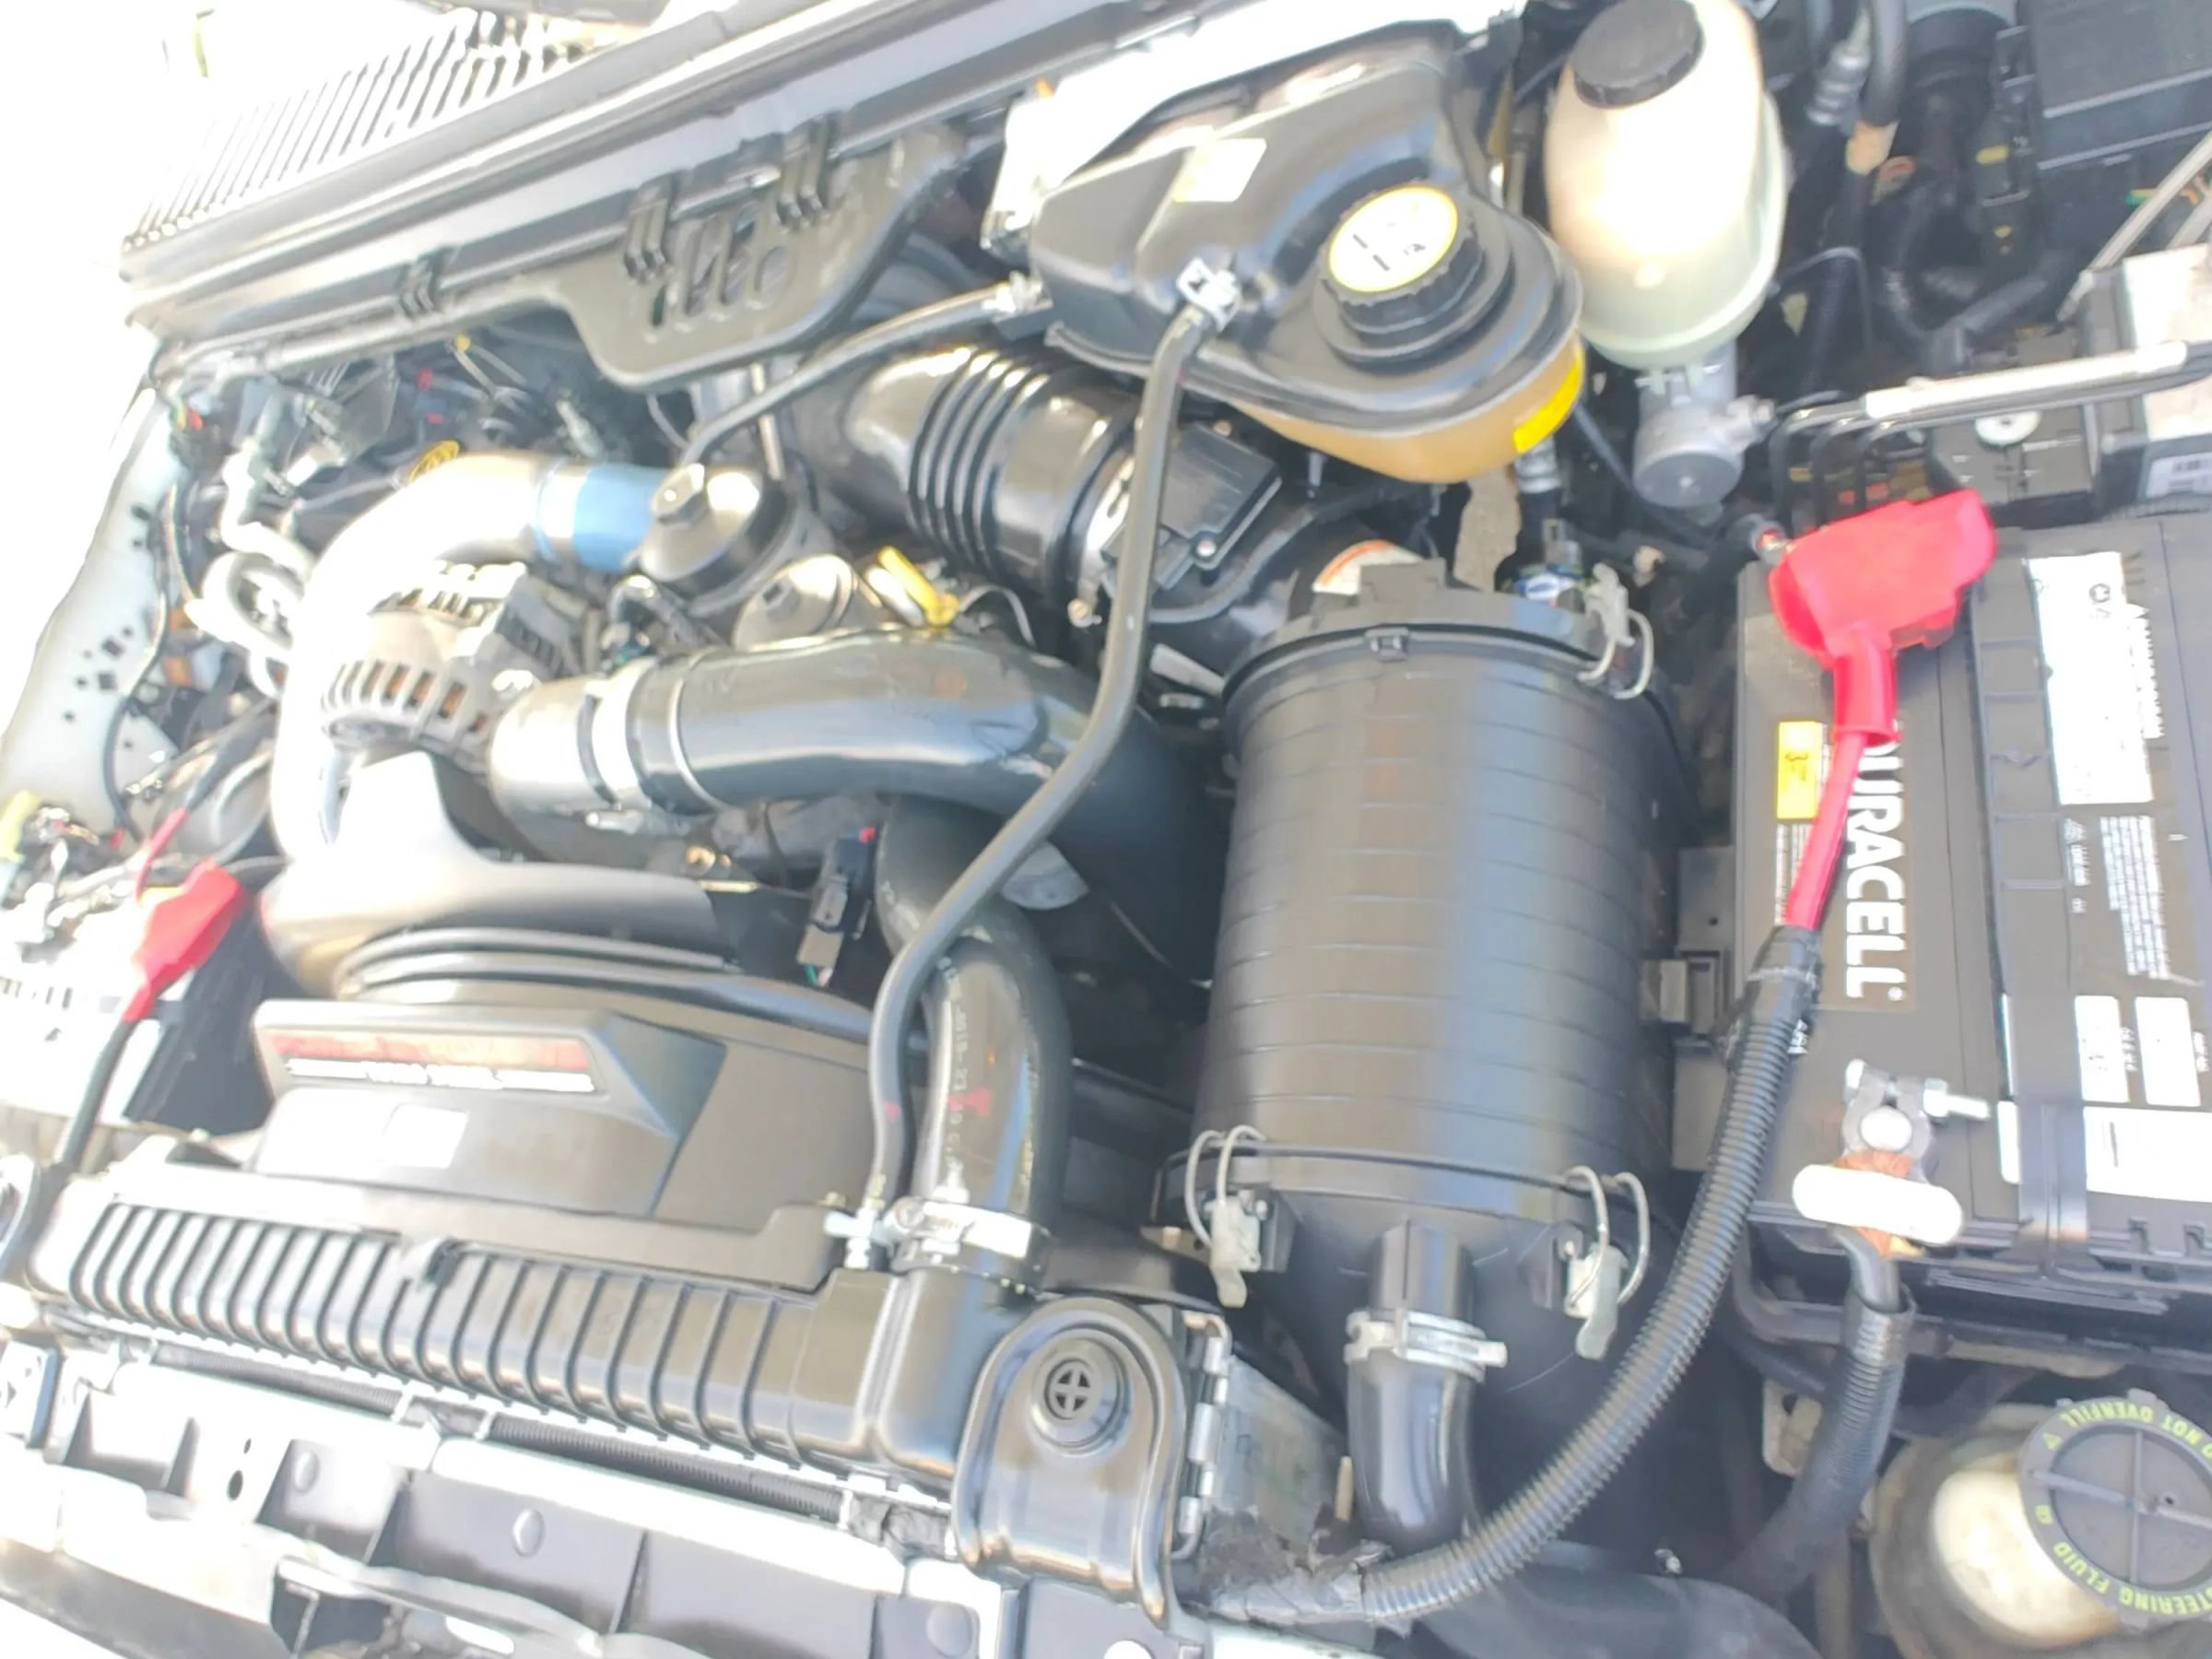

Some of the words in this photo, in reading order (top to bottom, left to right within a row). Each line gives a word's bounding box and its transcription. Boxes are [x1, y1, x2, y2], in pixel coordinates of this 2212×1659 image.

[2059, 1401, 2154, 1428] OVERFILL
[2161, 1415, 2203, 1446] NOT
[2053, 1541, 2110, 1594] FLUID
